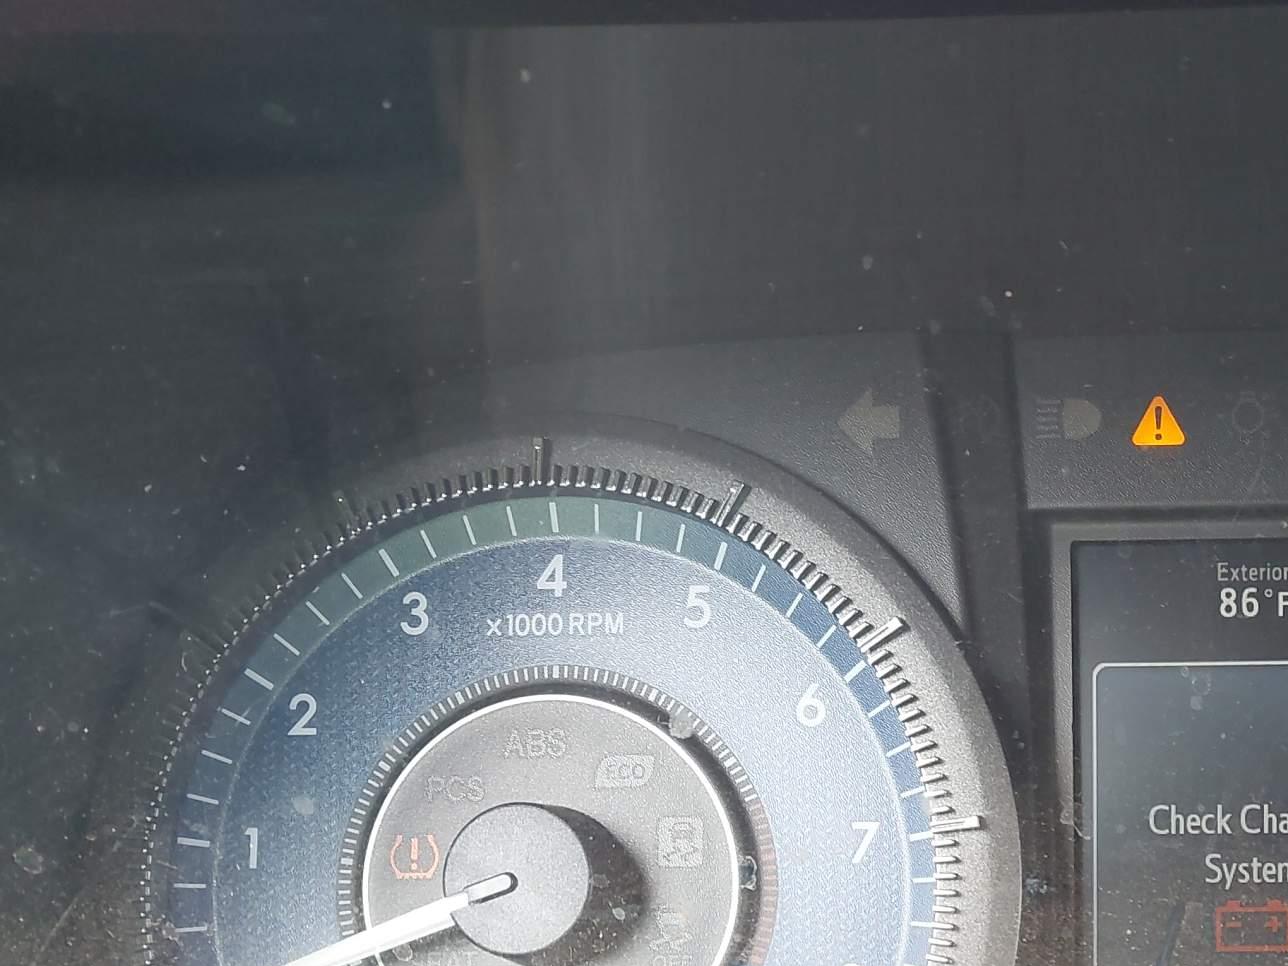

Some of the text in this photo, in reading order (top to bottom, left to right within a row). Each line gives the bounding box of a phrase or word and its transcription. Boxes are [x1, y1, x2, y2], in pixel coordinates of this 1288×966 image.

[536, 554, 567, 597] 4
[400, 592, 429, 636] 3
[487, 613, 624, 636] x1000 RPM
[683, 585, 711, 629] 5
[287, 693, 317, 736] 2
[796, 682, 826, 727] 6
[503, 728, 568, 759] ABS
[425, 776, 486, 802] PCS
[603, 764, 648, 782] ECO
[1148, 804, 1232, 836] Check
[243, 827, 260, 869] 1
[850, 821, 881, 864] 7
